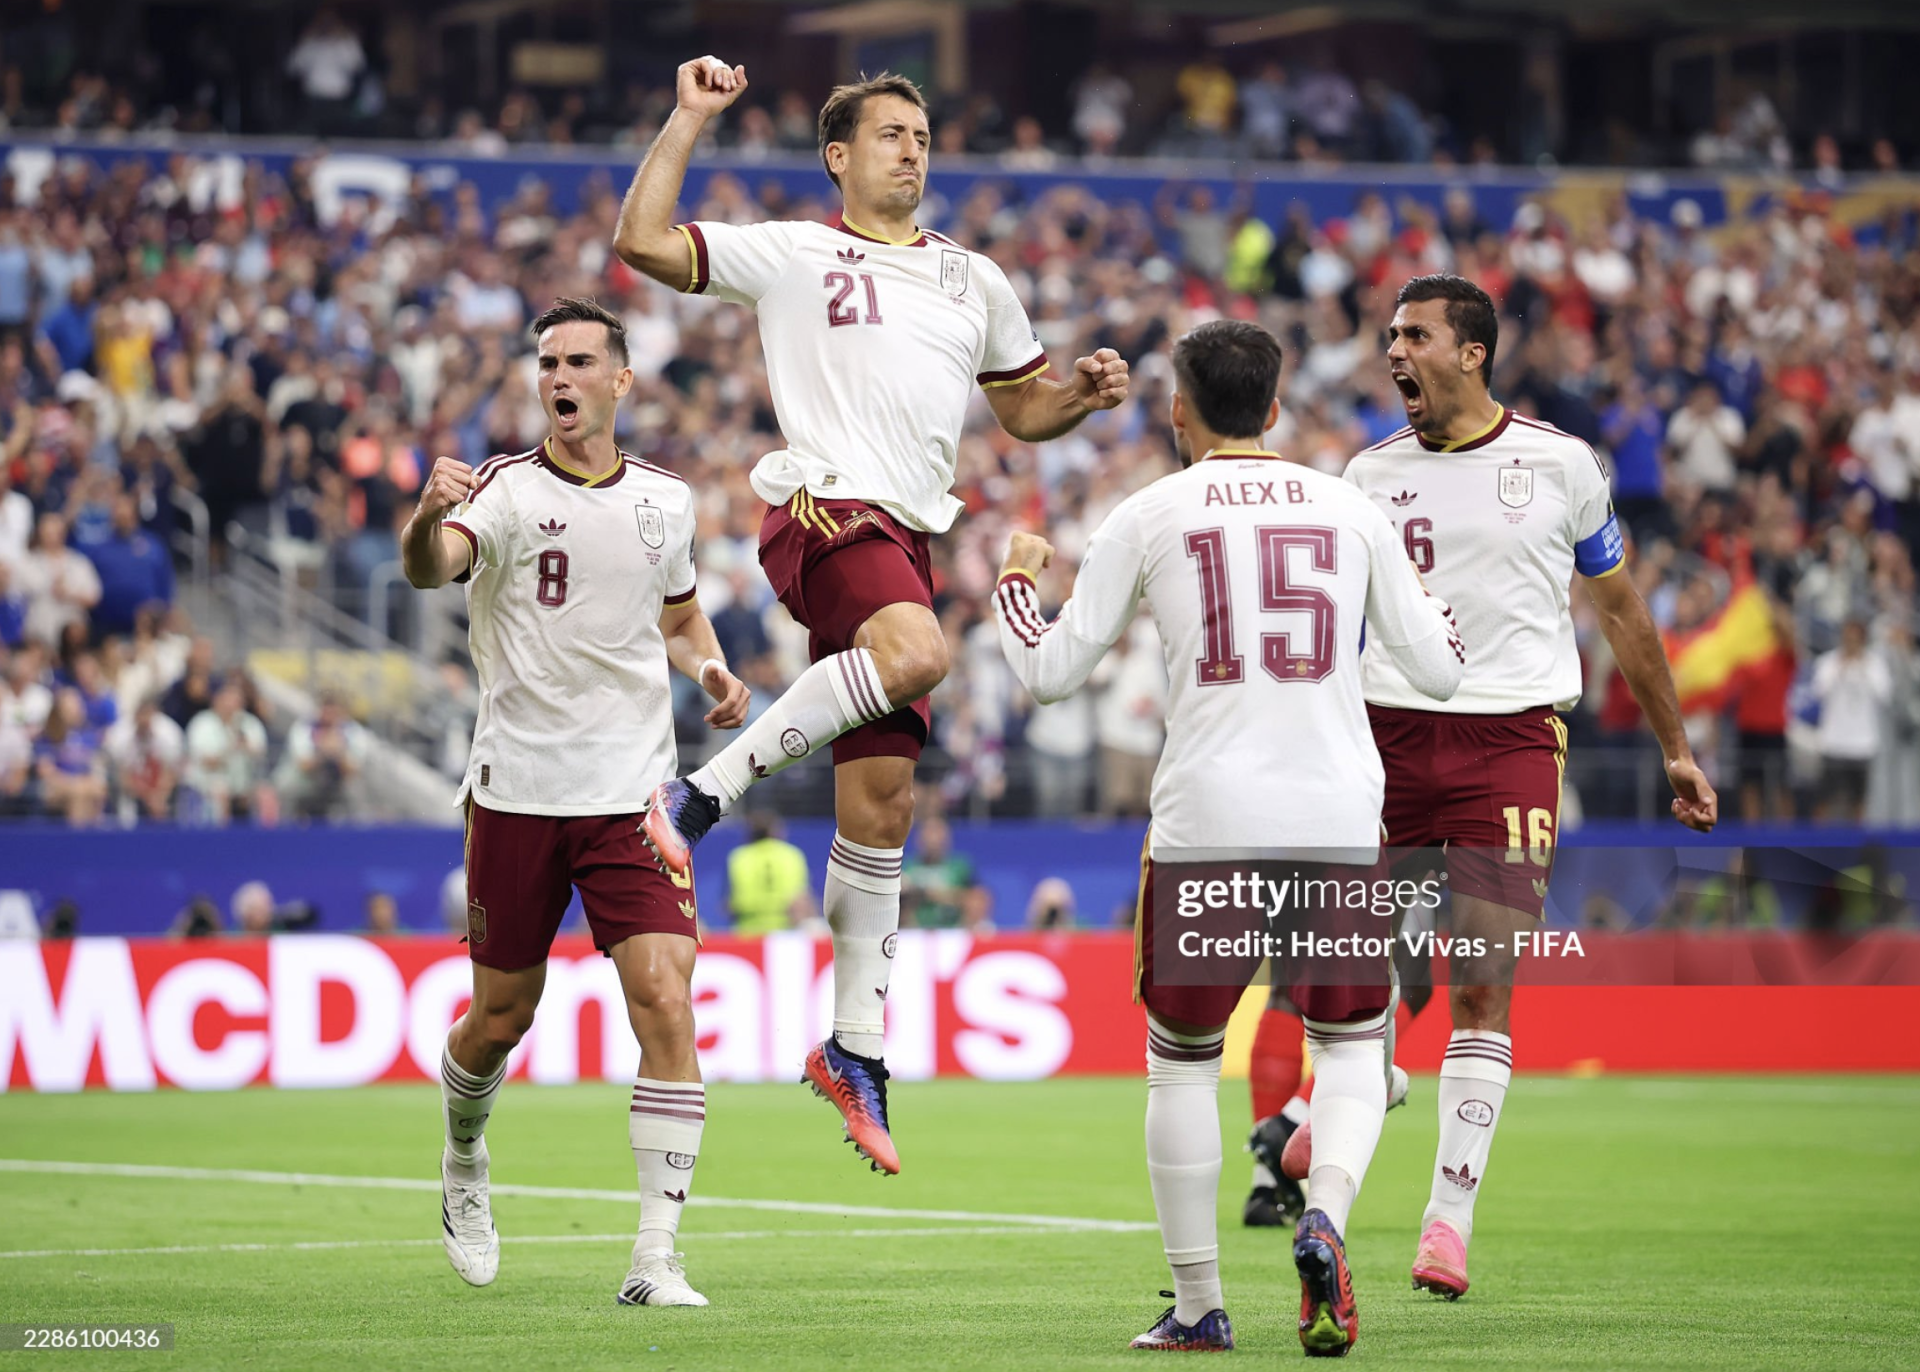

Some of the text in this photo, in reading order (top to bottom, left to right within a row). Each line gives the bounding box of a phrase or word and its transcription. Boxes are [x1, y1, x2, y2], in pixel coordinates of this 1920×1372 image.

[823, 270, 883, 328] 21
[1205, 481, 1312, 506] ALEX B.
[1391, 517, 1435, 574] 6
[536, 549, 569, 608] 8
[1183, 525, 1337, 687] 15
[1503, 806, 1552, 868] 16
